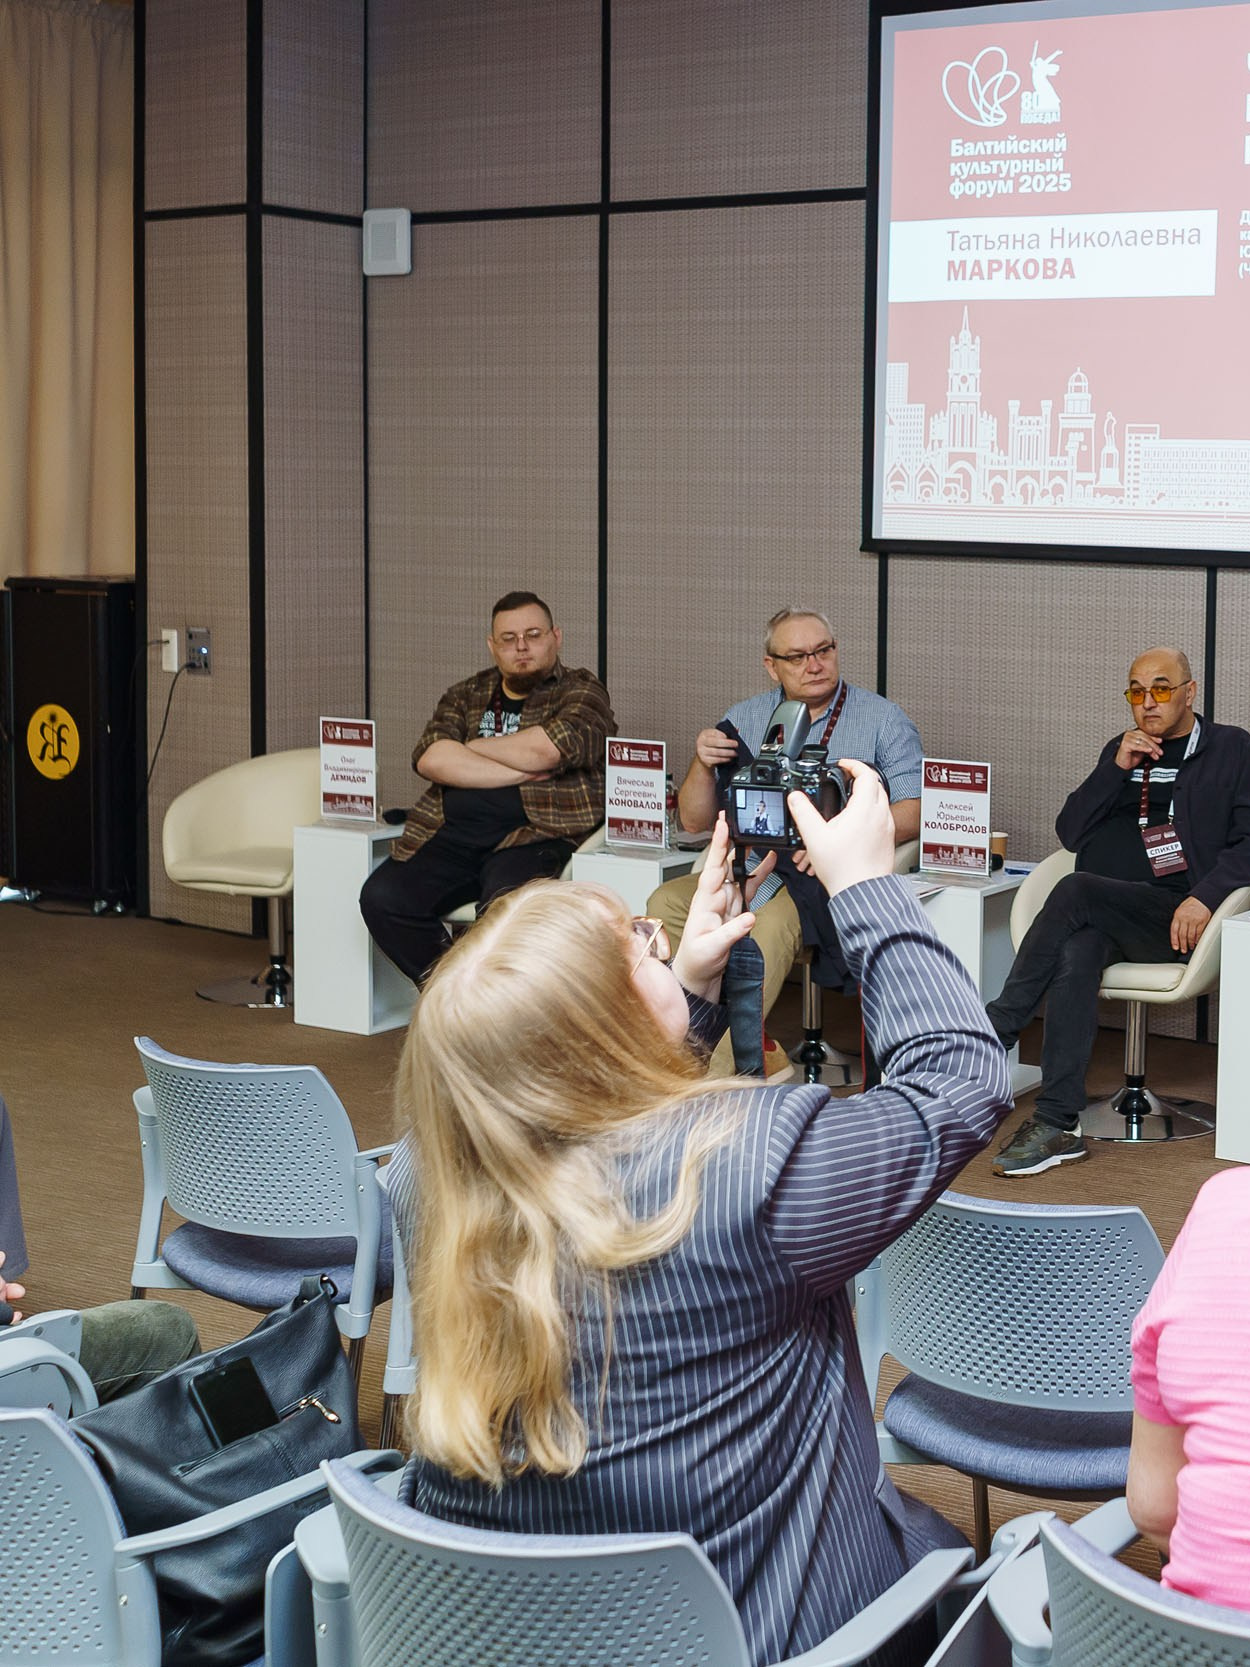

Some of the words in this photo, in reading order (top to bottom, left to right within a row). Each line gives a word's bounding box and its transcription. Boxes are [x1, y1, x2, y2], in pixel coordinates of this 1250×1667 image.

[950, 133, 1067, 157] Балтийский
[950, 153, 1064, 179] культурный
[949, 178, 1014, 199] форум
[1018, 173, 1072, 193] 2025
[947, 230, 1040, 252] Татьяна
[1050, 227, 1201, 249] Николаевна
[947, 257, 1076, 281] МАРКОВА
[616, 776, 654, 788] Вячеслав
[614, 787, 657, 799] Сергеевич
[608, 798, 663, 811] КОНОВАЛОВ
[938, 801, 974, 812] Алексей
[936, 811, 975, 822] Юрьевич
[924, 821, 987, 834] КОЛОБРОДОВ
[1150, 843, 1179, 856] СПИКЕР
